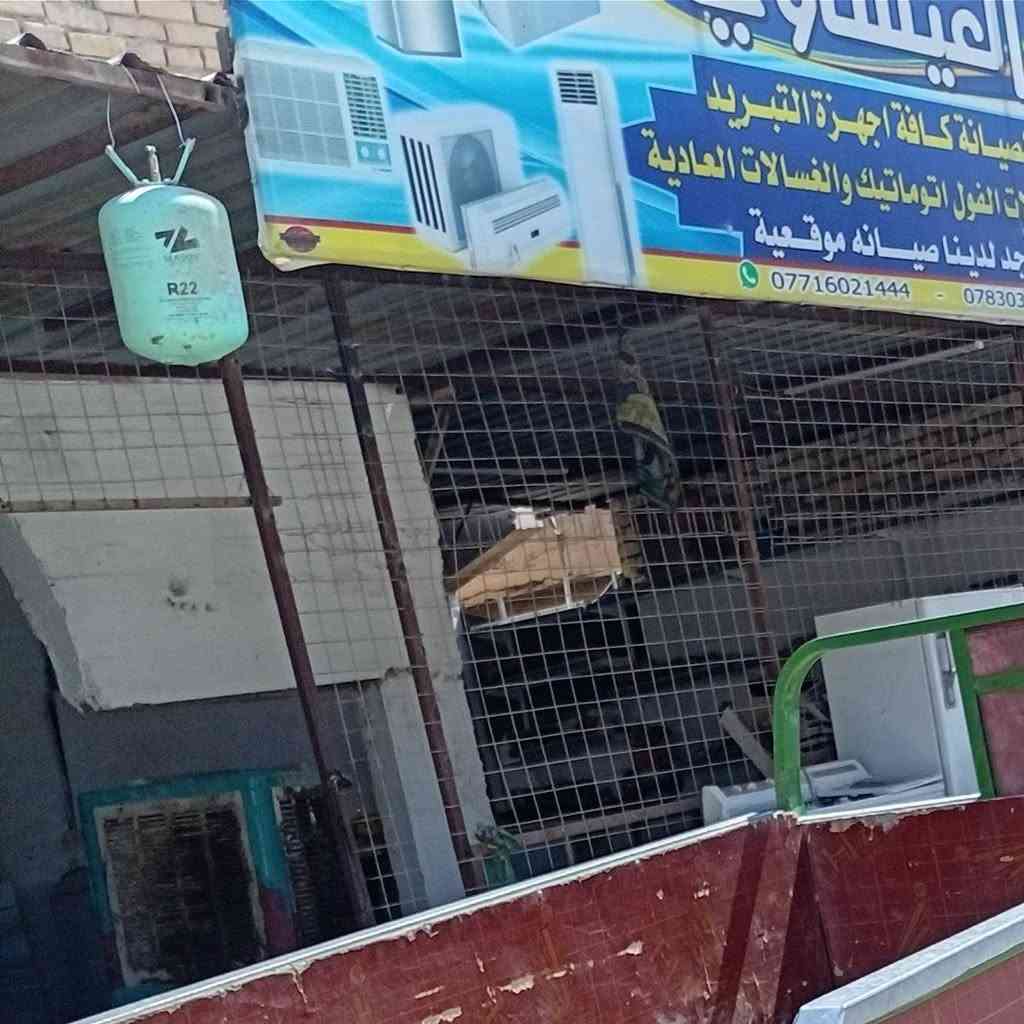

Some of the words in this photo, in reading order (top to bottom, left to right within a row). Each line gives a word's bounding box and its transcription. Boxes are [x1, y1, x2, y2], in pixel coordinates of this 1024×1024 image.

[706, 76, 810, 133] التبريد
[811, 88, 891, 149] اجهزة
[890, 101, 954, 151] كافة
[641, 127, 735, 188] العادية
[740, 146, 854, 205] والغسالات
[855, 167, 948, 213] اتوماتيك
[952, 181, 1001, 222] الفول
[748, 207, 846, 262] موقعية
[943, 234, 996, 279] لدينا
[167, 281, 198, 296] R22
[771, 270, 911, 299] 07716021444
